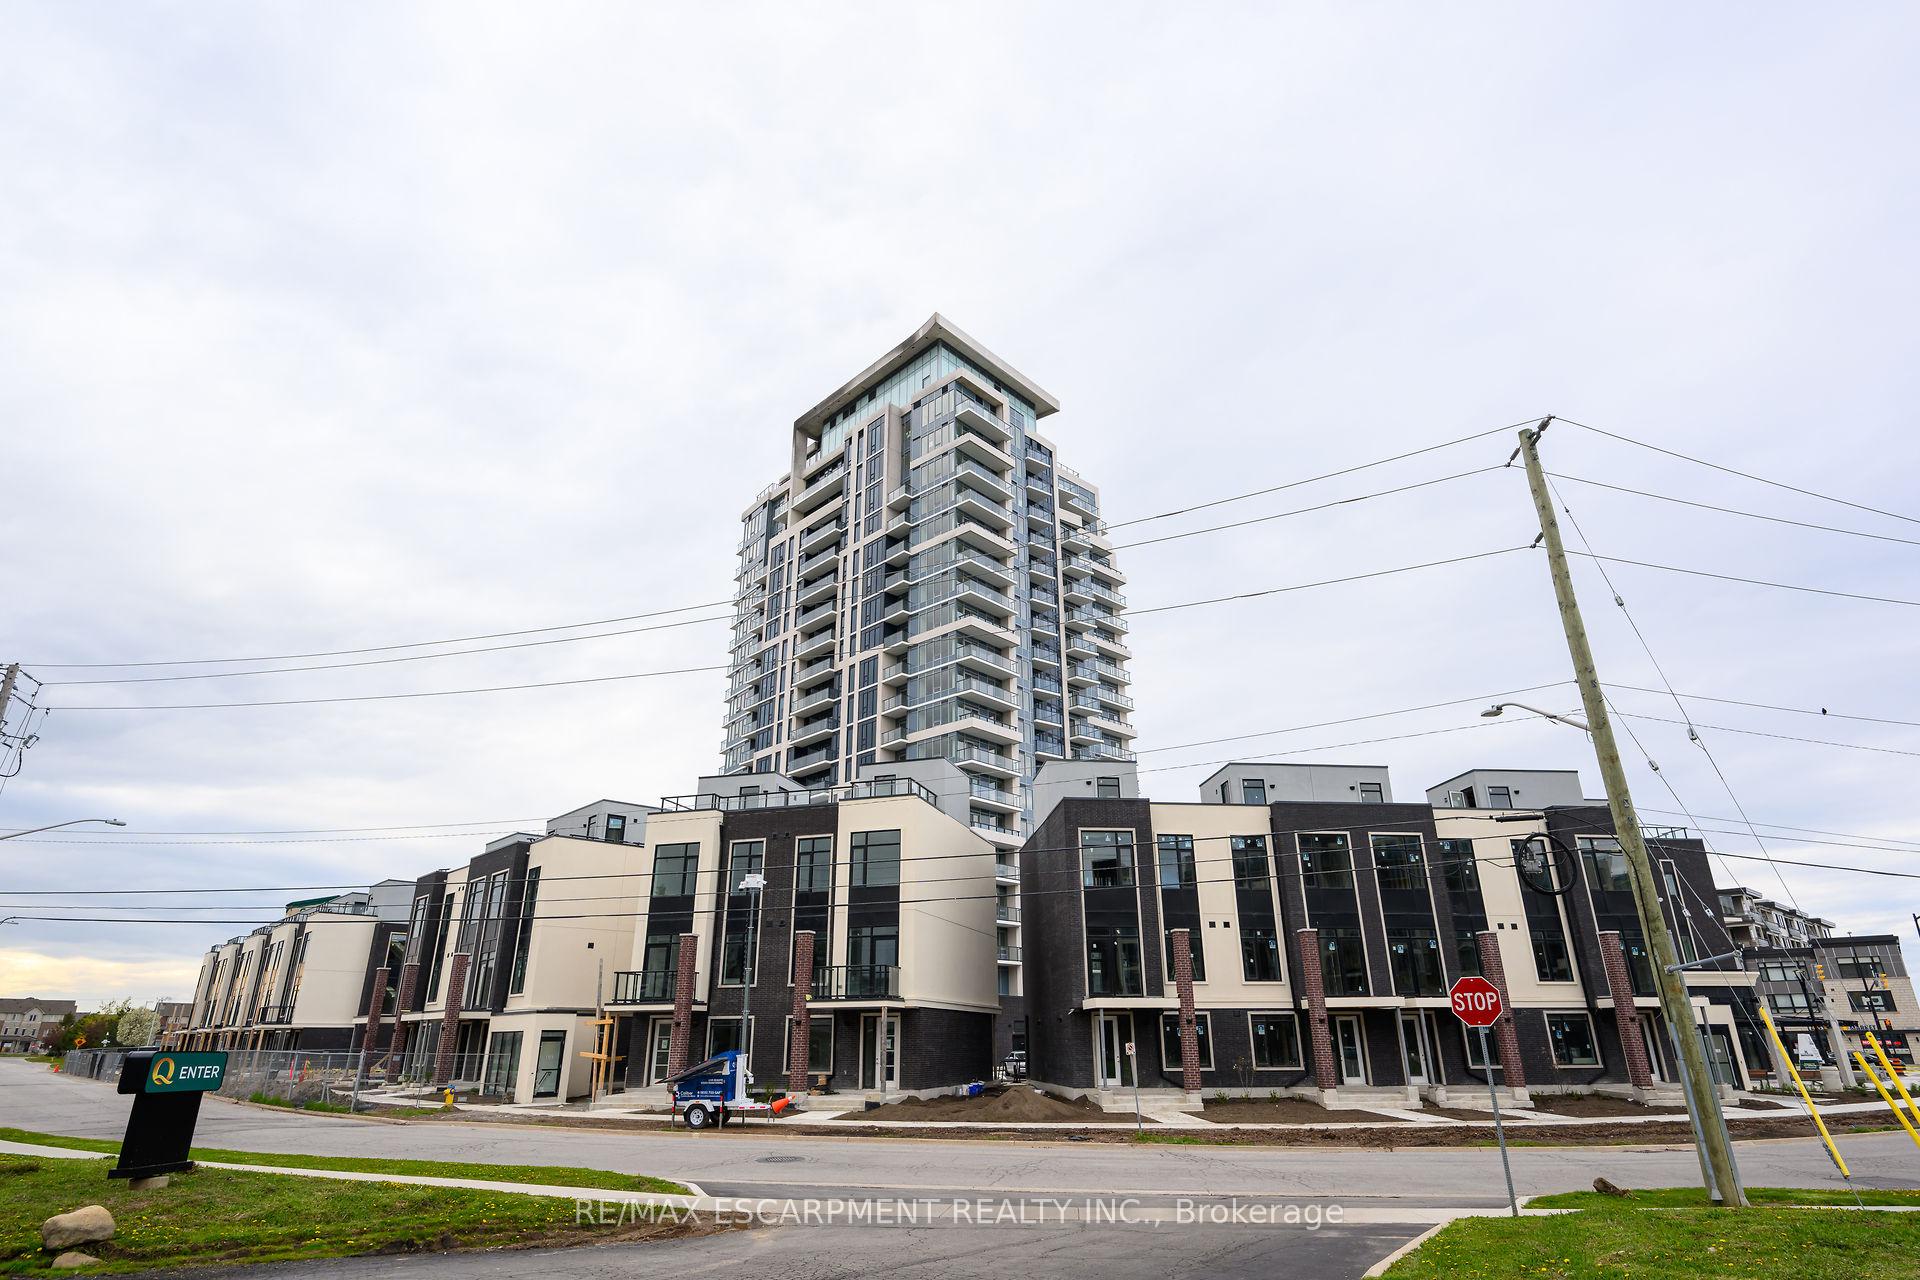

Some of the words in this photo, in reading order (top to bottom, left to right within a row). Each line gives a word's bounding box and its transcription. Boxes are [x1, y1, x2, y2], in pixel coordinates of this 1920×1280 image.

[1453, 992, 1498, 1011] STOP
[152, 1057, 175, 1085] Q
[179, 1065, 220, 1080] ENTER
